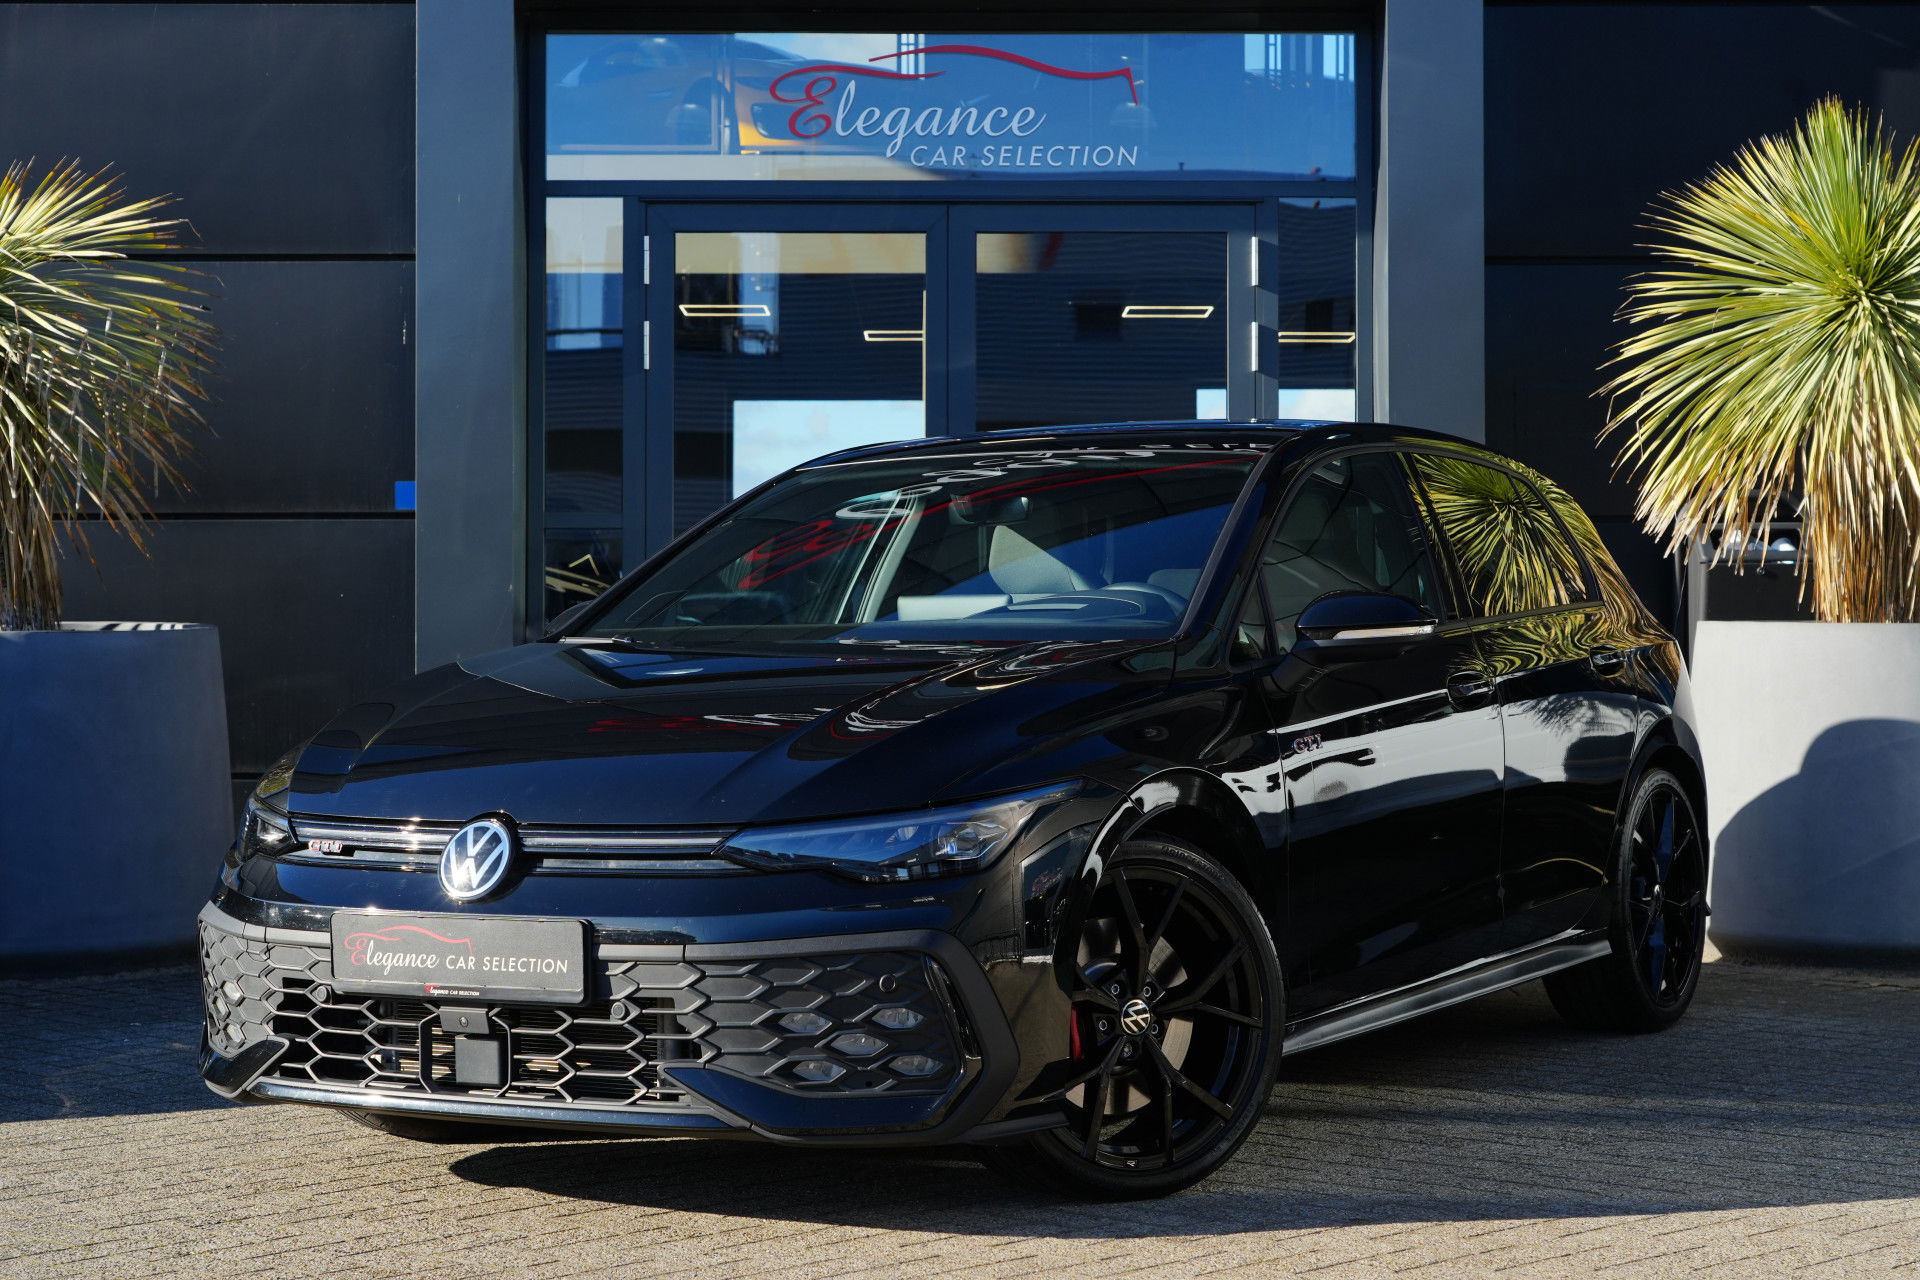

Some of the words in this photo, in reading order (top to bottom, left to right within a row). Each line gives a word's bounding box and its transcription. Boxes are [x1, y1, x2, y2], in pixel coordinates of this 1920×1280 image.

[769, 65, 1047, 158] Elegance
[910, 145, 966, 167] CAR
[980, 145, 1139, 167] SELECTION
[1294, 733, 1323, 754] GTI
[344, 932, 440, 975] Elegance
[446, 955, 475, 970] CAR
[483, 957, 568, 974] SELECTION
